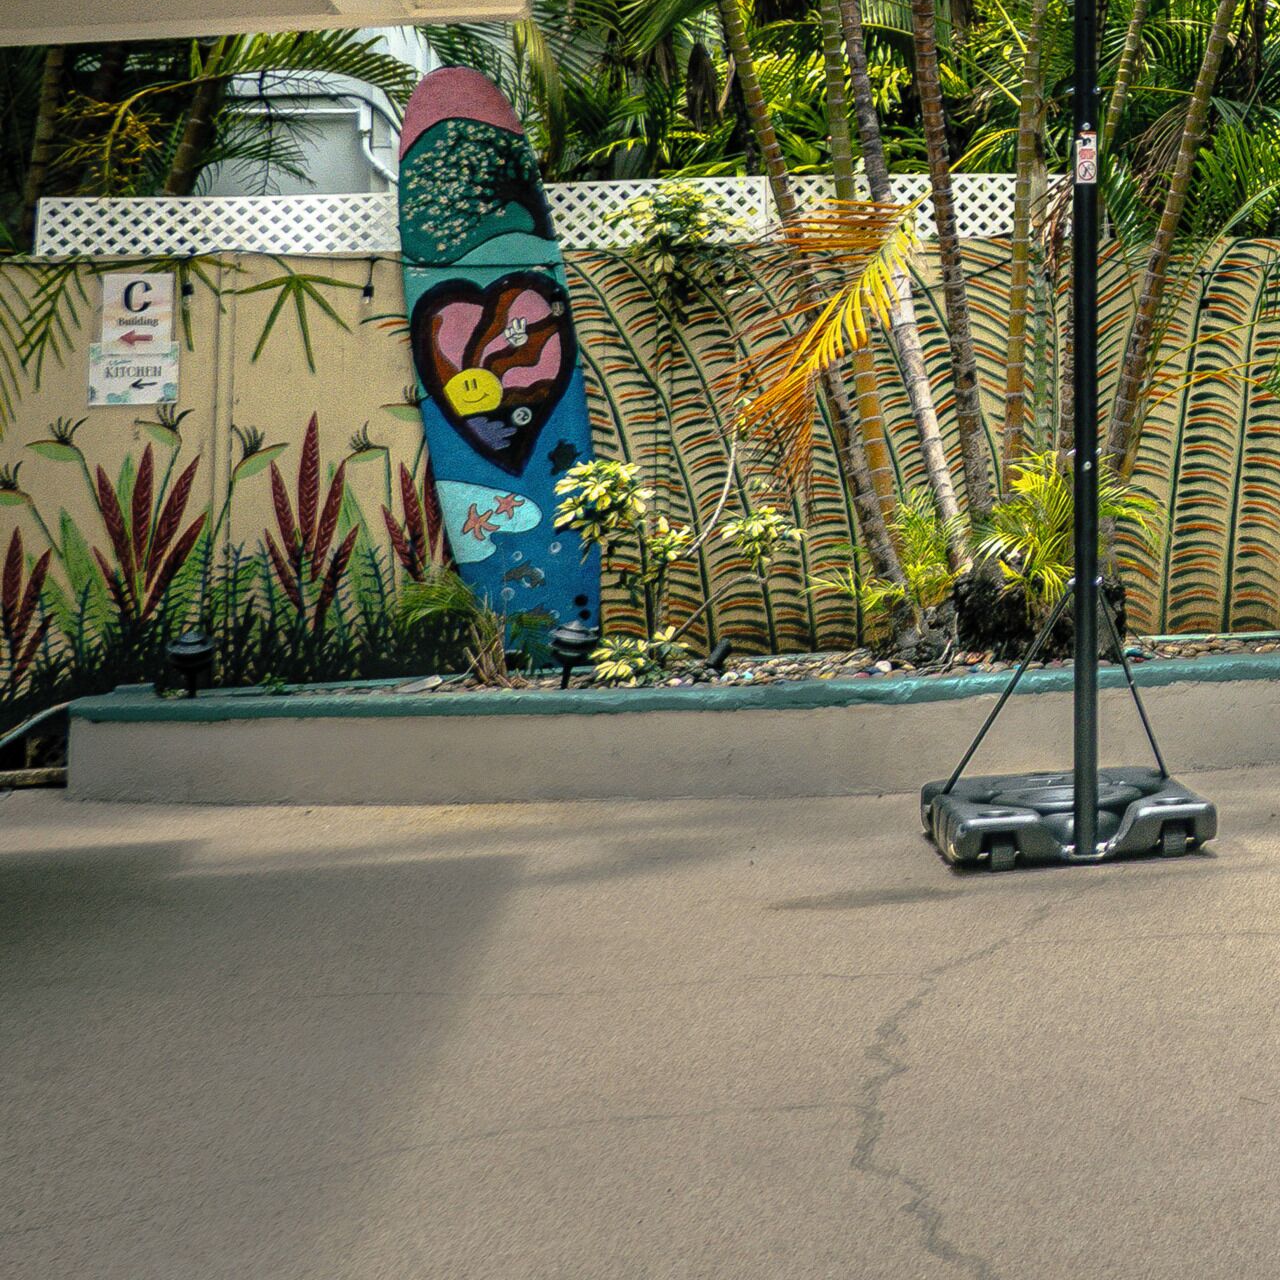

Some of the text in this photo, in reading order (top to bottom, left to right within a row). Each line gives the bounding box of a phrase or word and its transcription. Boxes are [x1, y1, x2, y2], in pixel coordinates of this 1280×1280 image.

[124, 281, 152, 313] C
[118, 316, 159, 328] Building
[104, 366, 162, 378] KITCHEN
